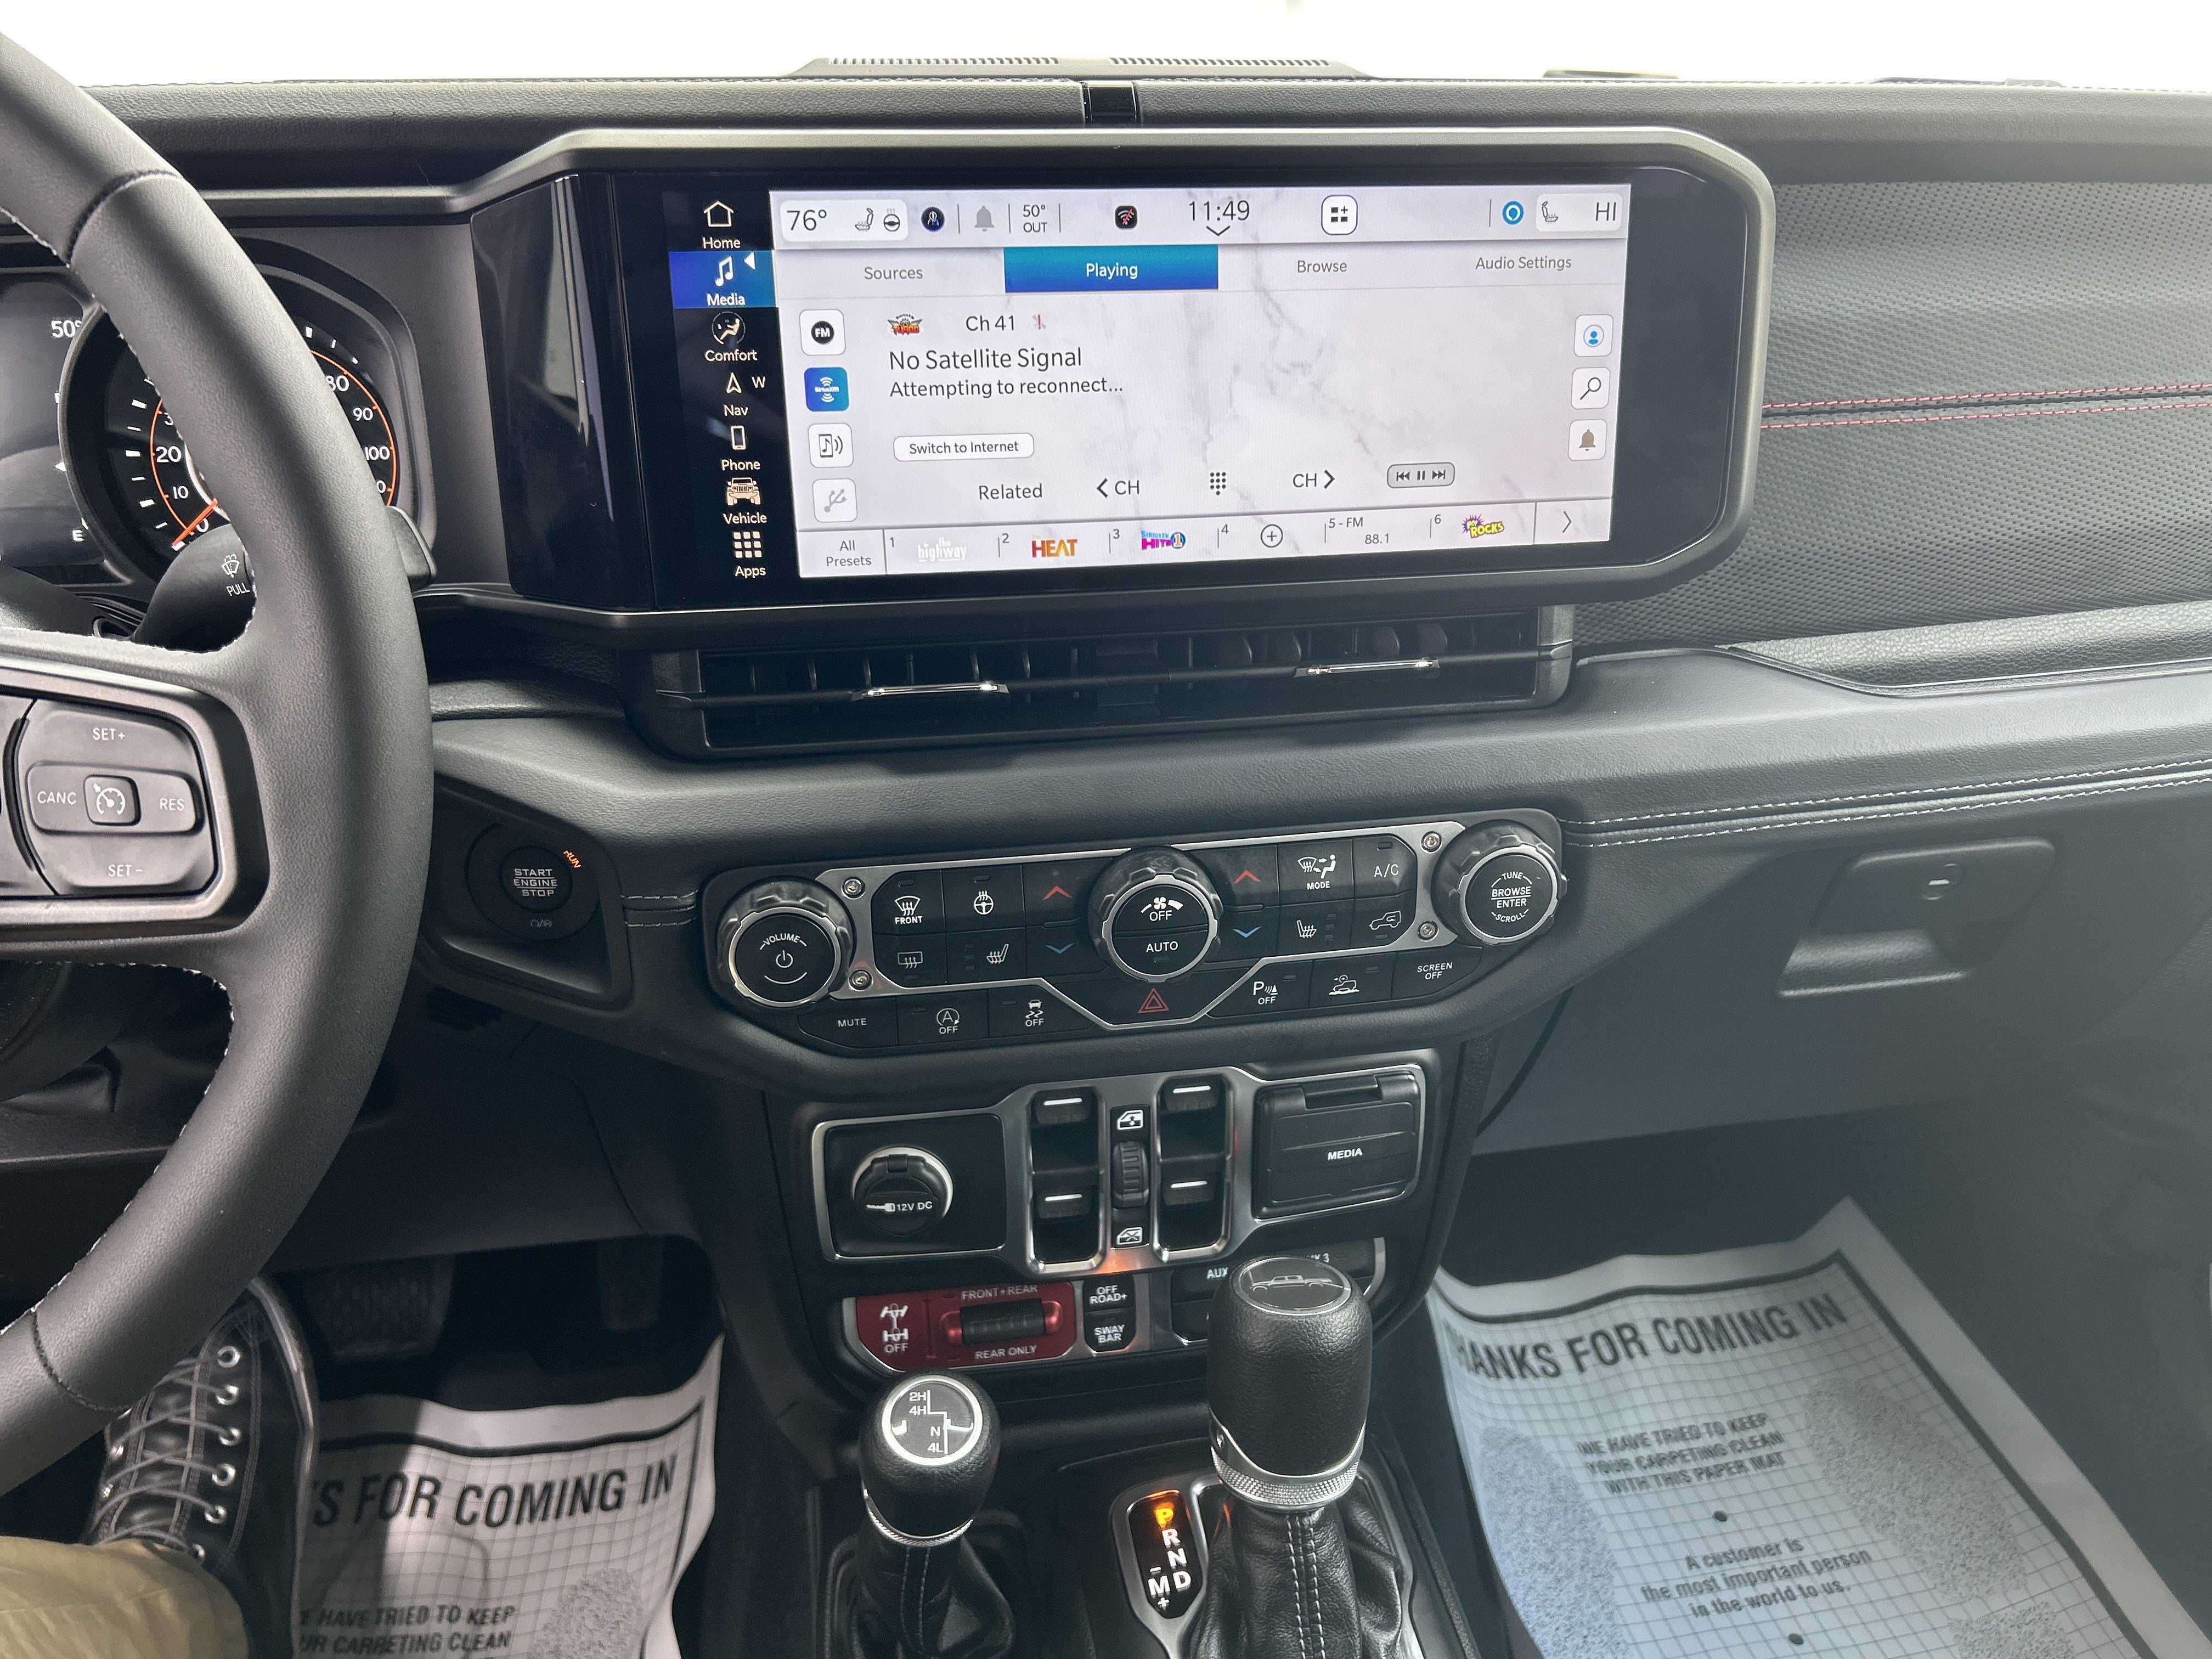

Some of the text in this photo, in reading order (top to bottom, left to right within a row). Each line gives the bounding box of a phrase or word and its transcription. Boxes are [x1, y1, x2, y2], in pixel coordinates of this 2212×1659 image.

[1188, 200, 1250, 221] 11:49
[1595, 202, 1617, 222] HI
[1023, 222, 1047, 233] OUT
[702, 238, 741, 250] Home
[1297, 260, 1347, 273] Browse
[1475, 255, 1572, 272] Audio Settings
[864, 266, 923, 280] Sources
[1086, 262, 1138, 279] Playing
[707, 293, 746, 306] Media
[966, 315, 1015, 331] Ch 41
[815, 328, 831, 338] FM
[705, 349, 758, 362] Comfort
[890, 347, 1082, 372] No Satellite Signal
[752, 377, 765, 388] W
[890, 377, 1123, 399] Attempting to reconnect...
[353, 408, 374, 421] 90
[724, 405, 748, 416] Nav
[156, 446, 182, 462] 20
[364, 446, 390, 460] 100
[909, 440, 1019, 455] Switch to Internet
[721, 459, 760, 471] Phone
[1293, 473, 1317, 488] CH
[173, 486, 189, 499] 10
[979, 483, 1042, 500] Related
[1114, 480, 1140, 495] CH
[723, 512, 767, 524] Vehicle
[1328, 518, 1335, 528] 5
[1346, 517, 1363, 528] FM
[1434, 514, 1441, 524] 6
[1113, 529, 1120, 539] 3
[1222, 524, 1229, 535] 4
[1470, 521, 1504, 538] ROCKS
[890, 537, 895, 548] 1
[1002, 533, 1009, 544] 2
[1365, 534, 1390, 545] 88.1
[839, 540, 855, 551] All
[1031, 539, 1077, 558] HEAT
[918, 543, 967, 562] highway
[826, 555, 871, 567] Presets
[735, 566, 766, 578] Apps
[226, 583, 251, 597] PULL
[37, 791, 77, 805] CANC
[160, 798, 185, 811] RES
[563, 850, 582, 869] RUN
[514, 868, 552, 877] START
[1373, 863, 1400, 877] A/C
[1502, 871, 1523, 880] TUNE
[514, 878, 558, 887] ENGINE
[1307, 881, 1330, 890] MODE
[1492, 886, 1531, 898] BROWSE
[1497, 898, 1527, 909] ENTER
[895, 916, 923, 925] FRONT
[1149, 910, 1172, 922] OFF
[1496, 912, 1525, 922] SCROLL
[763, 933, 800, 946] VOLUME
[1146, 940, 1178, 953] AUTO
[1417, 961, 1453, 974] SCREEN
[1424, 970, 1443, 981] OFF
[1257, 996, 1276, 1005] OFF
[838, 1018, 867, 1028] MUTE
[1025, 1018, 1045, 1027] OFF
[939, 1025, 958, 1035] OFF
[1327, 1147, 1363, 1161] MEDIA
[896, 1200, 933, 1212] 12V DC
[1206, 1267, 1229, 1279] AUX
[1097, 1284, 1119, 1296] OFF
[1090, 1291, 1127, 1305] ROAD+
[1094, 1324, 1125, 1336] SWAY
[1567, 1322, 1649, 1372] FOR
[1653, 1306, 1798, 1356] COMING
[1799, 1293, 1848, 1330] IN
[1098, 1332, 1122, 1344] BAR
[884, 1342, 908, 1354] OFF
[974, 1344, 1037, 1359] REAR ONLY
[909, 1391, 926, 1401] 2H
[909, 1405, 927, 1415] 4H
[930, 1426, 941, 1437] N
[1609, 1432, 1651, 1452] HAVE
[1652, 1423, 1701, 1446] TRIED
[1703, 1421, 1725, 1438] TO
[1727, 1412, 1769, 1433] KEEP
[927, 1442, 944, 1453] 4L
[1585, 1431, 1785, 1474] YOUR CARPETING CLEAN
[1605, 1452, 1786, 1494] WITH THIS PAPER MAT
[354, 1472, 442, 1522] FOR
[455, 1469, 628, 1527] COMING
[639, 1455, 677, 1505] IN
[1155, 1508, 1173, 1525] P
[1162, 1528, 1181, 1546] R
[1167, 1548, 1187, 1567] N
[1685, 1537, 1804, 1570] A customer is
[1173, 1571, 1191, 1590] D
[1641, 1549, 1872, 1602] the most important person
[1148, 1576, 1170, 1595] M
[1691, 1602, 1708, 1618] in
[1712, 1596, 1743, 1615] the
[1745, 1586, 1796, 1610] world
[1799, 1582, 1820, 1599] to
[318, 1610, 369, 1626] HAVE
[376, 1606, 430, 1626] TRIED
[437, 1605, 462, 1624] TO
[466, 1606, 515, 1625] KEEP
[448, 1630, 514, 1652] CLEAN
